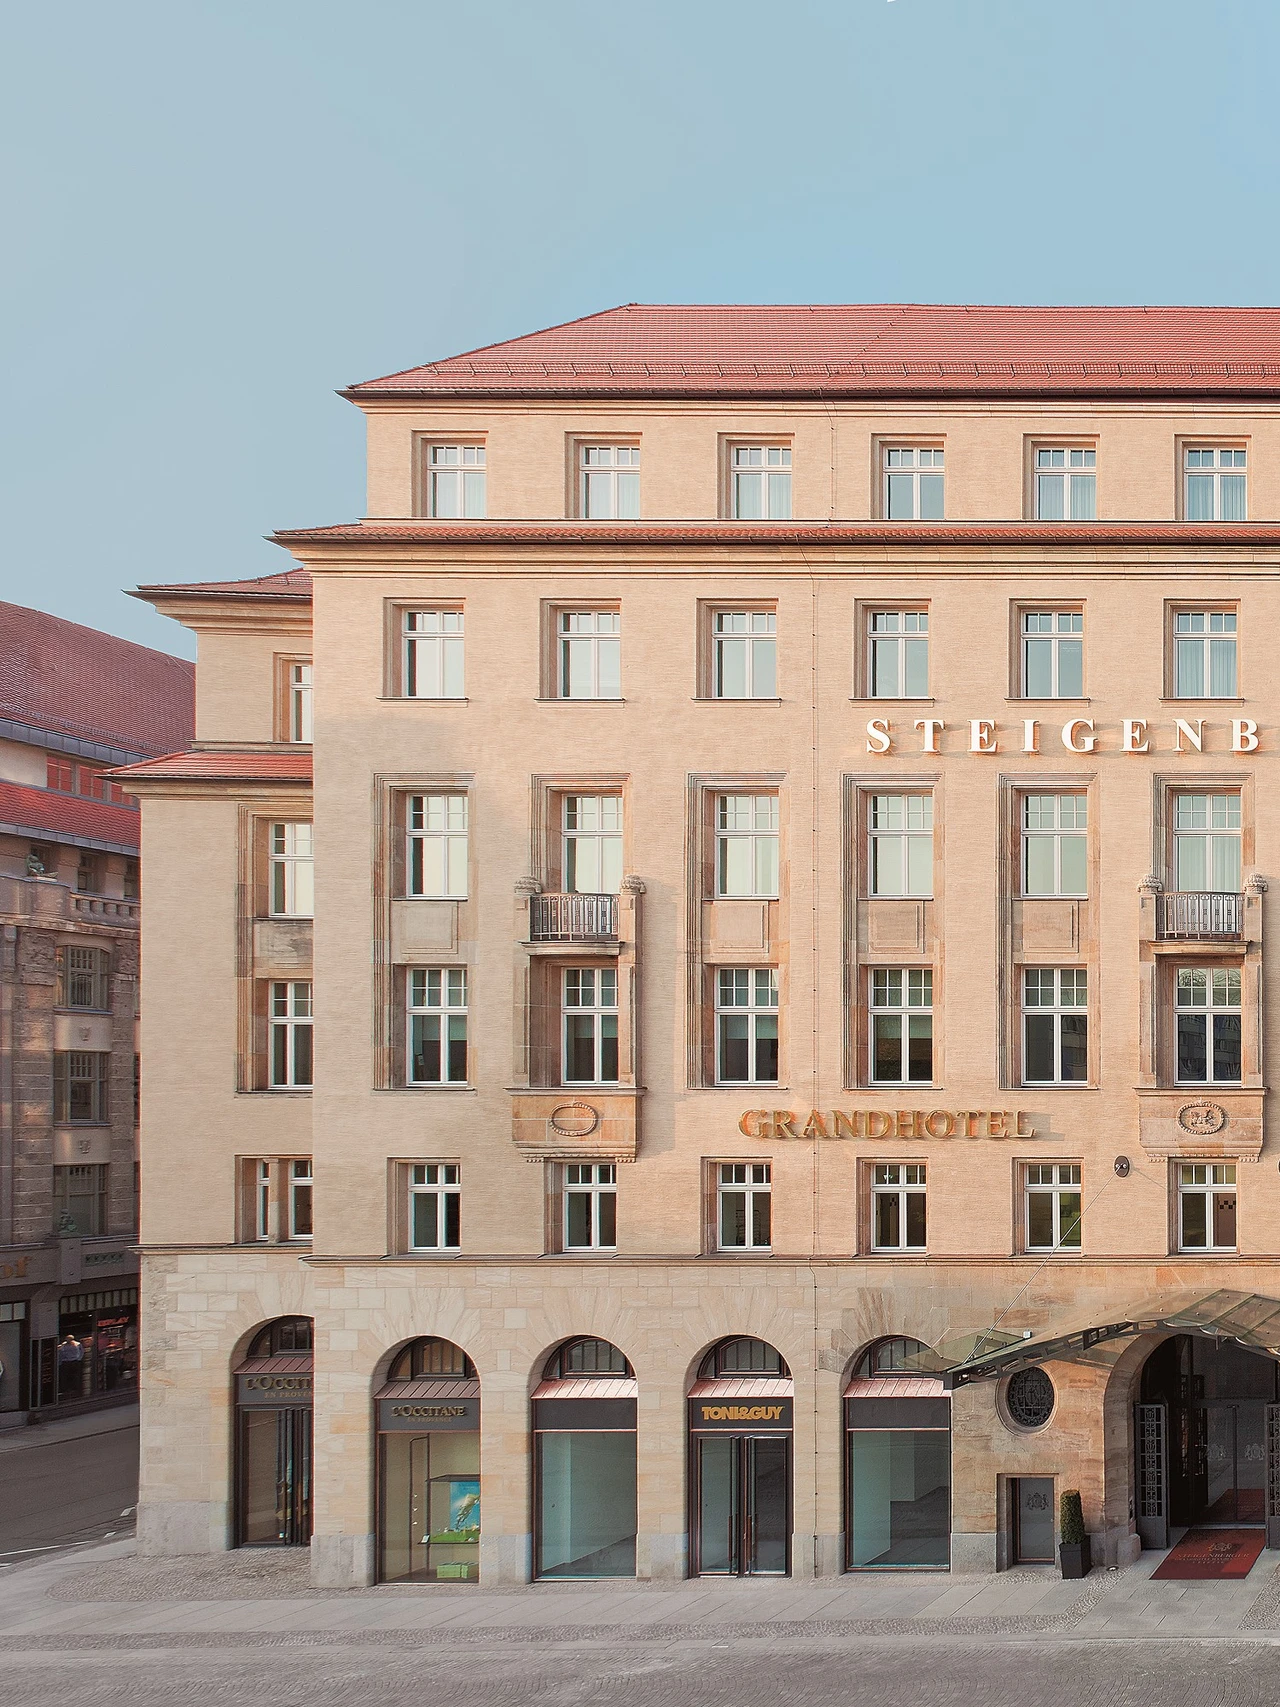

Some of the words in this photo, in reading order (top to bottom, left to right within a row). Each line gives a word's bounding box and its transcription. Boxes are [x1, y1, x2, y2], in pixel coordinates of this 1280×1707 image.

[738, 1109, 1037, 1139] GRANDHOTEL
[245, 1375, 313, 1390] L'OCCIT
[701, 1406, 784, 1420] TONI&GUY
